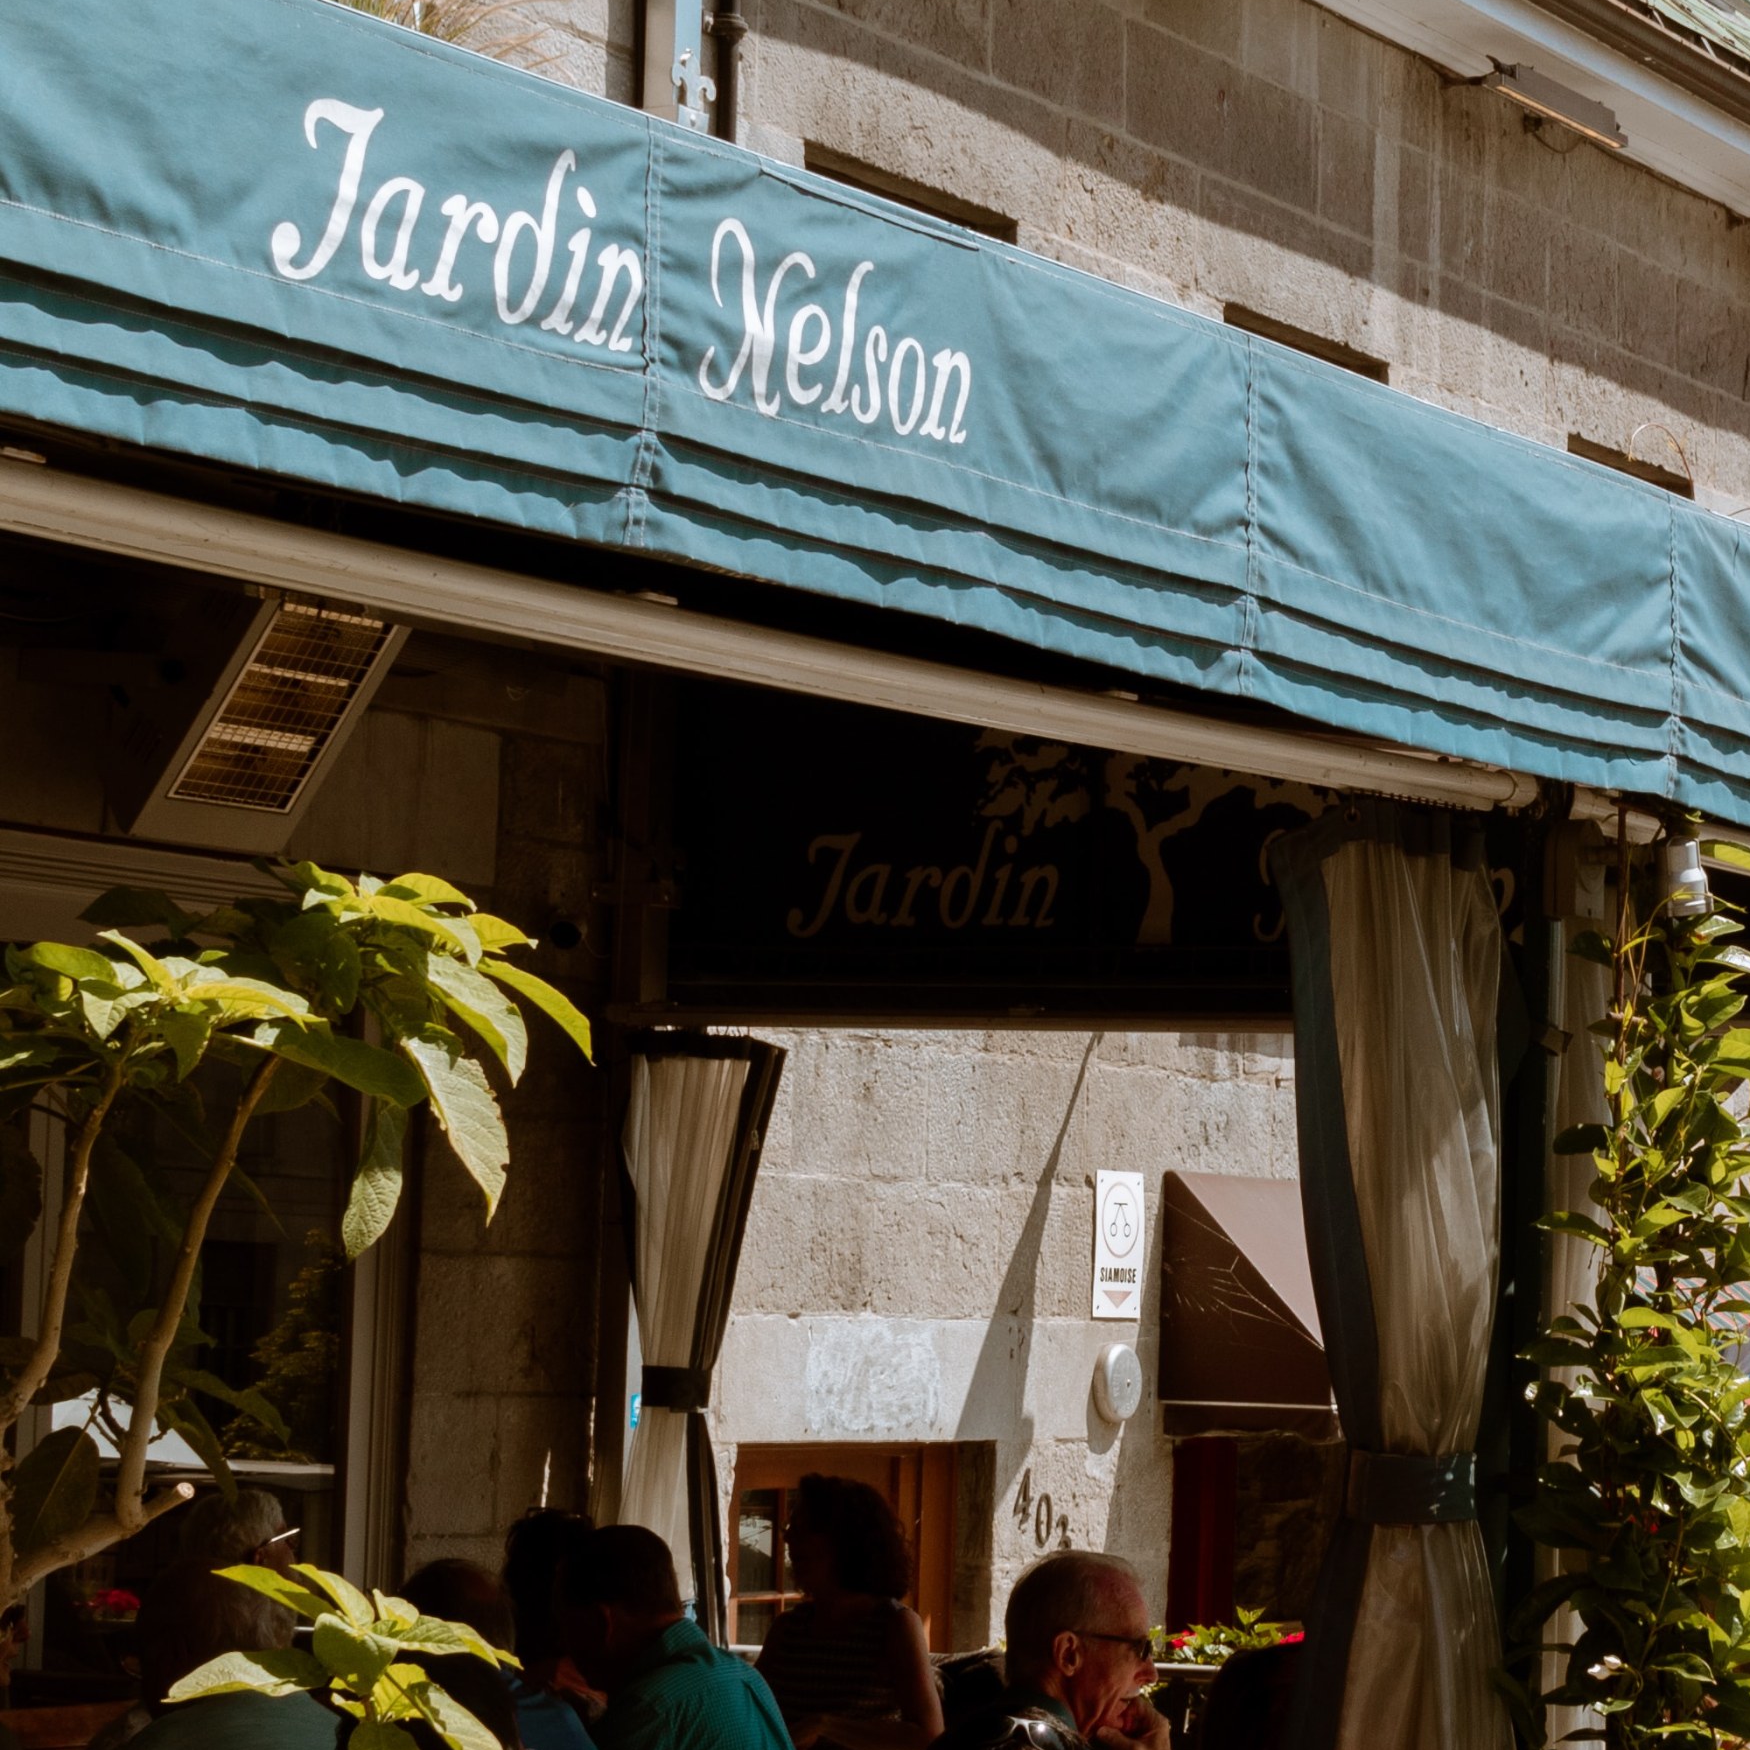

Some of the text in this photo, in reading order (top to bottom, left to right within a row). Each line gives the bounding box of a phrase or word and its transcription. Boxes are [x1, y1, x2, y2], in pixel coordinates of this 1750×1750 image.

[271, 97, 973, 444] Jardin Nelson
[786, 816, 1060, 939] Jardin
[1100, 1266, 1137, 1284] SIAMOISE
